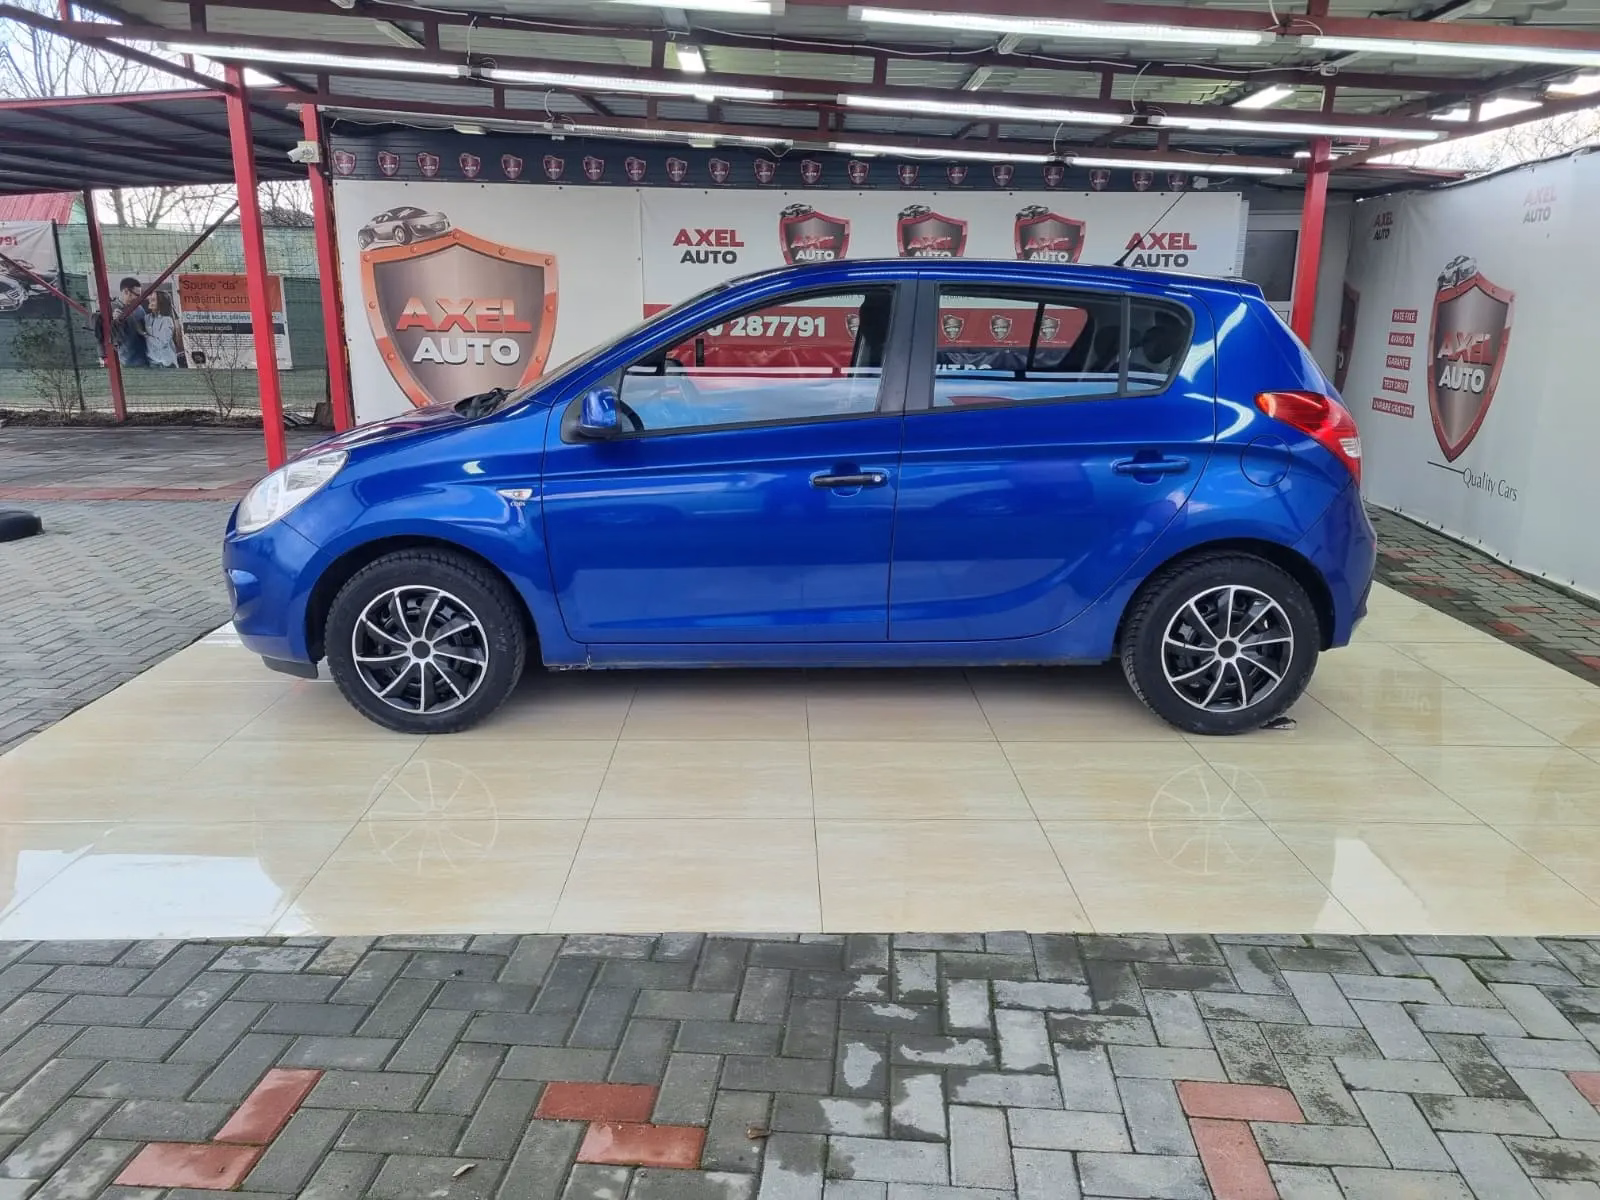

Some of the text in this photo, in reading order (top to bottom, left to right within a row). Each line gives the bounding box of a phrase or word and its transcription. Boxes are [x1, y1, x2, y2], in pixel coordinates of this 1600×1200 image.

[1523, 206, 1551, 224] AUTO
[672, 228, 745, 247] AXEL
[1125, 232, 1197, 250] AXEL
[680, 250, 737, 264] AUTO
[796, 251, 835, 260] AUTO
[1030, 252, 1069, 262] AUTO
[1131, 253, 1189, 268] AUTO
[396, 297, 532, 333] AXEL
[729, 316, 825, 337] 287791
[412, 336, 520, 365] AUTO
[1437, 331, 1492, 366] AXEL
[1438, 365, 1485, 393] AUTO
[1463, 468, 1518, 501] Quality Cars
